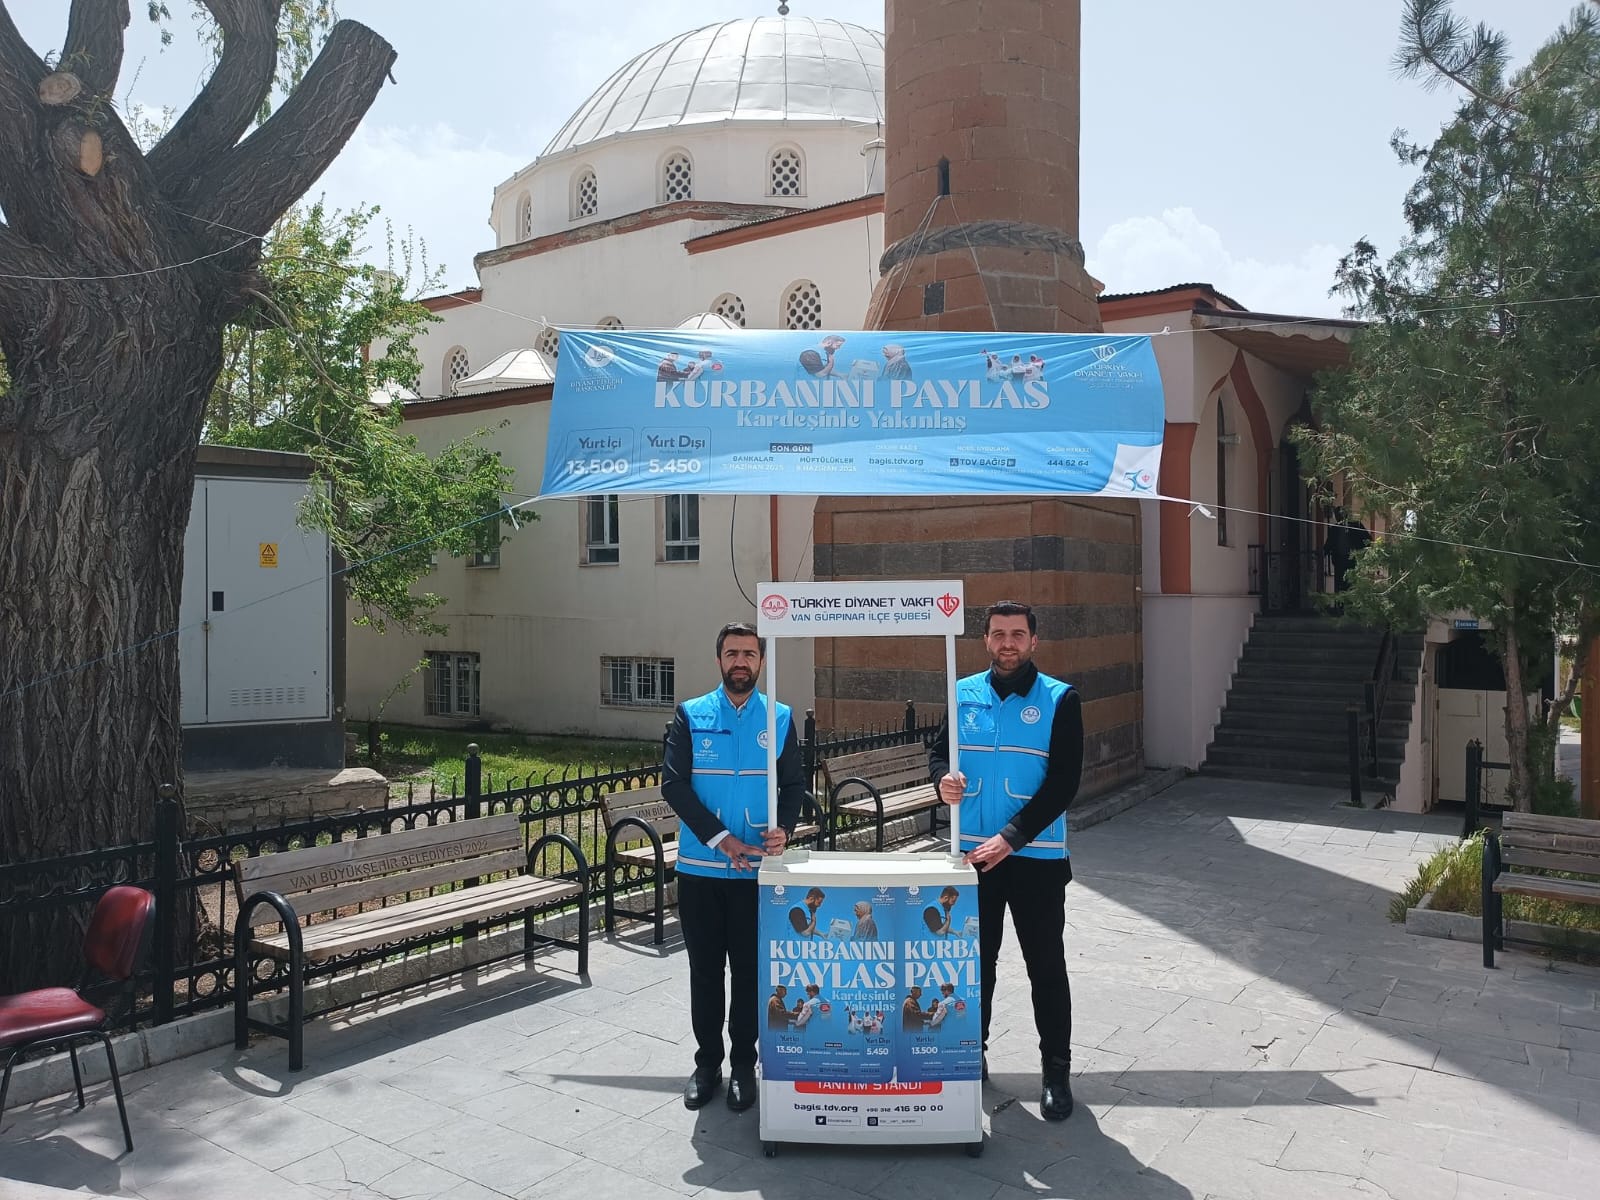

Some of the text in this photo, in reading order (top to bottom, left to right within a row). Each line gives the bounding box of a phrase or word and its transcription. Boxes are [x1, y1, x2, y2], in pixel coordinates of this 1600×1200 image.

[655, 379, 874, 408] KURBANINI
[736, 409, 968, 432] Kardeşinle Yakınlaş
[578, 437, 606, 449] Yurt
[646, 434, 706, 450] Yurt Dışı
[792, 444, 811, 453] GÜN
[567, 458, 629, 475] 13.500
[648, 458, 702, 474] 5.450
[868, 457, 924, 466] bagis.tdv.org
[1047, 459, 1063, 467] 444
[790, 596, 934, 609] TÜRKİYE DİYANET VAKFI
[791, 609, 931, 624] VAN GÜRPINAR İLÇE ŞUBESİ
[290, 839, 489, 889] VAN BÜYÜKŞEHİR BELEDİYESİ 2022
[769, 939, 896, 961] KURBANINI
[904, 938, 981, 960] KURBA
[832, 989, 896, 1002] Kardeşinle
[845, 1001, 896, 1013] Yakınlaş
[776, 1045, 803, 1054] 13.500
[866, 1047, 889, 1056] 5.450
[911, 1046, 939, 1055] 13.500
[794, 1103, 859, 1113] bagis.tdv.org
[930, 1104, 944, 1112] 00
